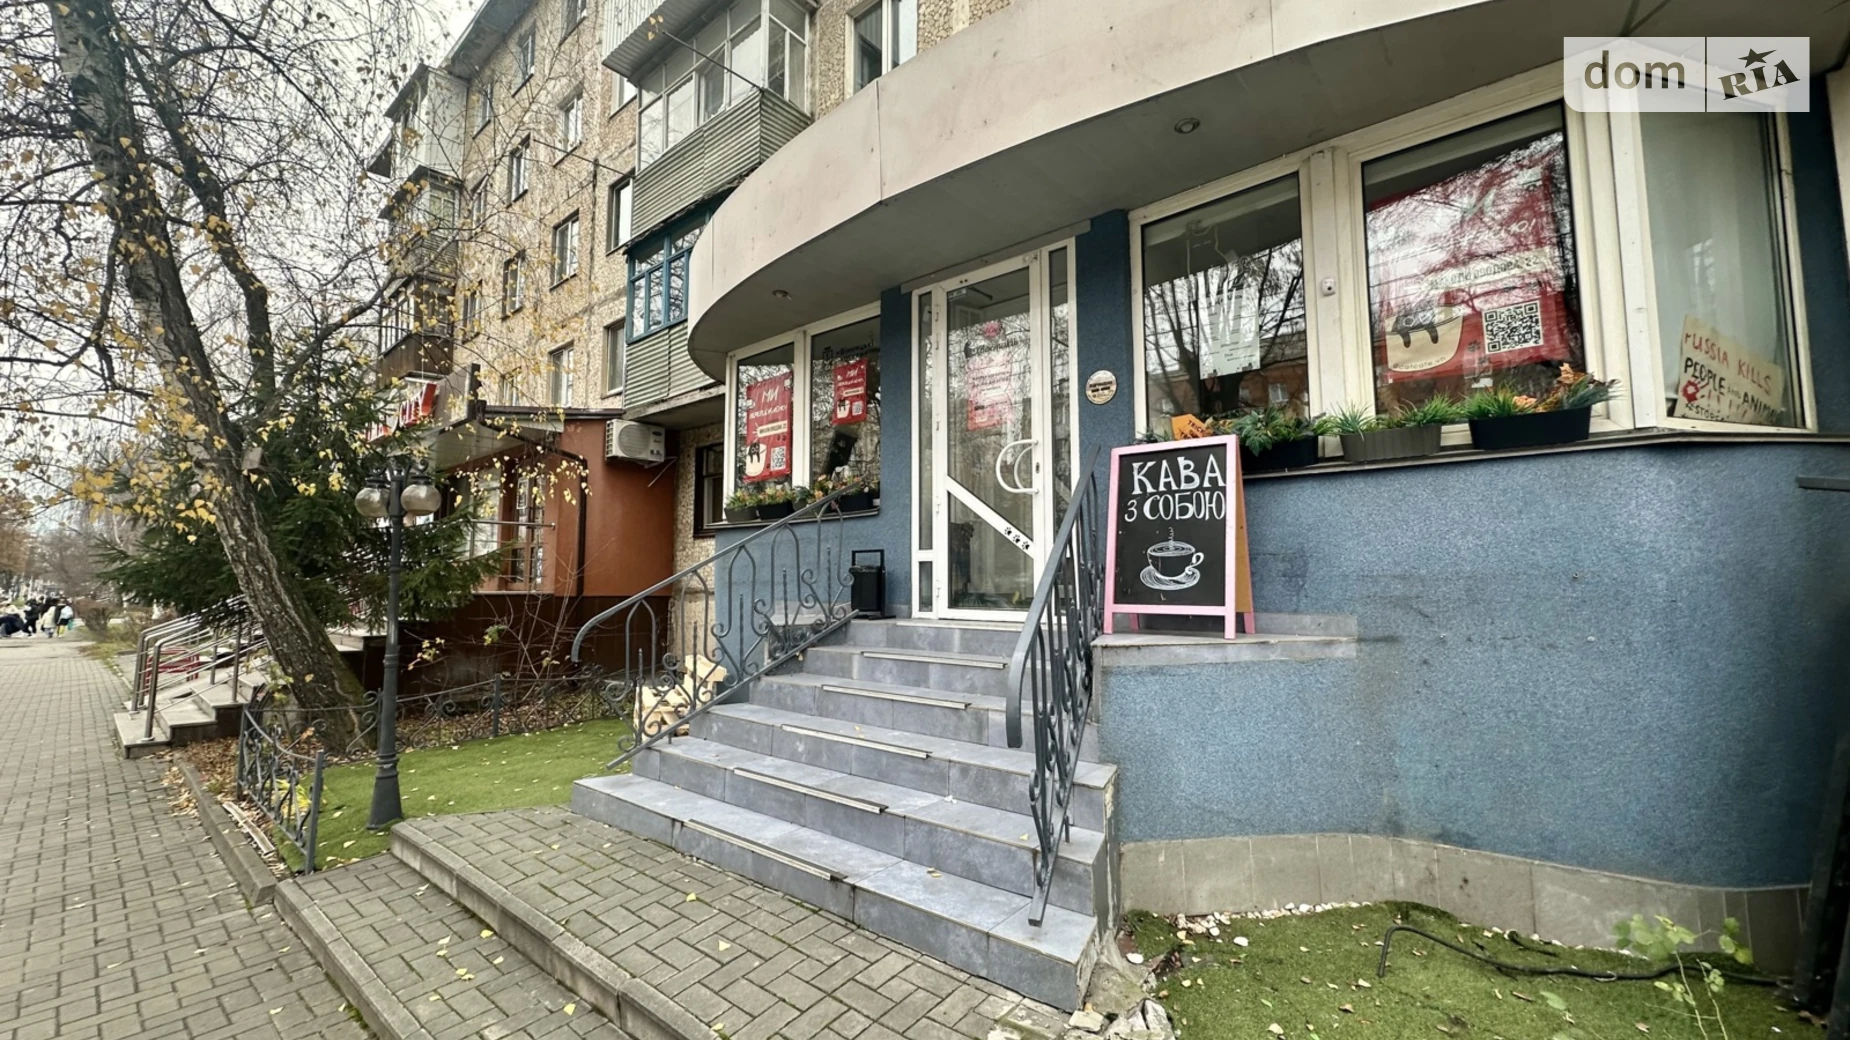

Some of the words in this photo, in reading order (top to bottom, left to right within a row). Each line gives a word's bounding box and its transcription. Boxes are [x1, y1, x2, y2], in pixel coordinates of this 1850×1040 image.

[1684, 357, 1726, 396] PEOPLE
[1738, 359, 1771, 397] KILLS
[1131, 453, 1226, 495] КАВА
[1142, 490, 1226, 521] СОБОЮ
